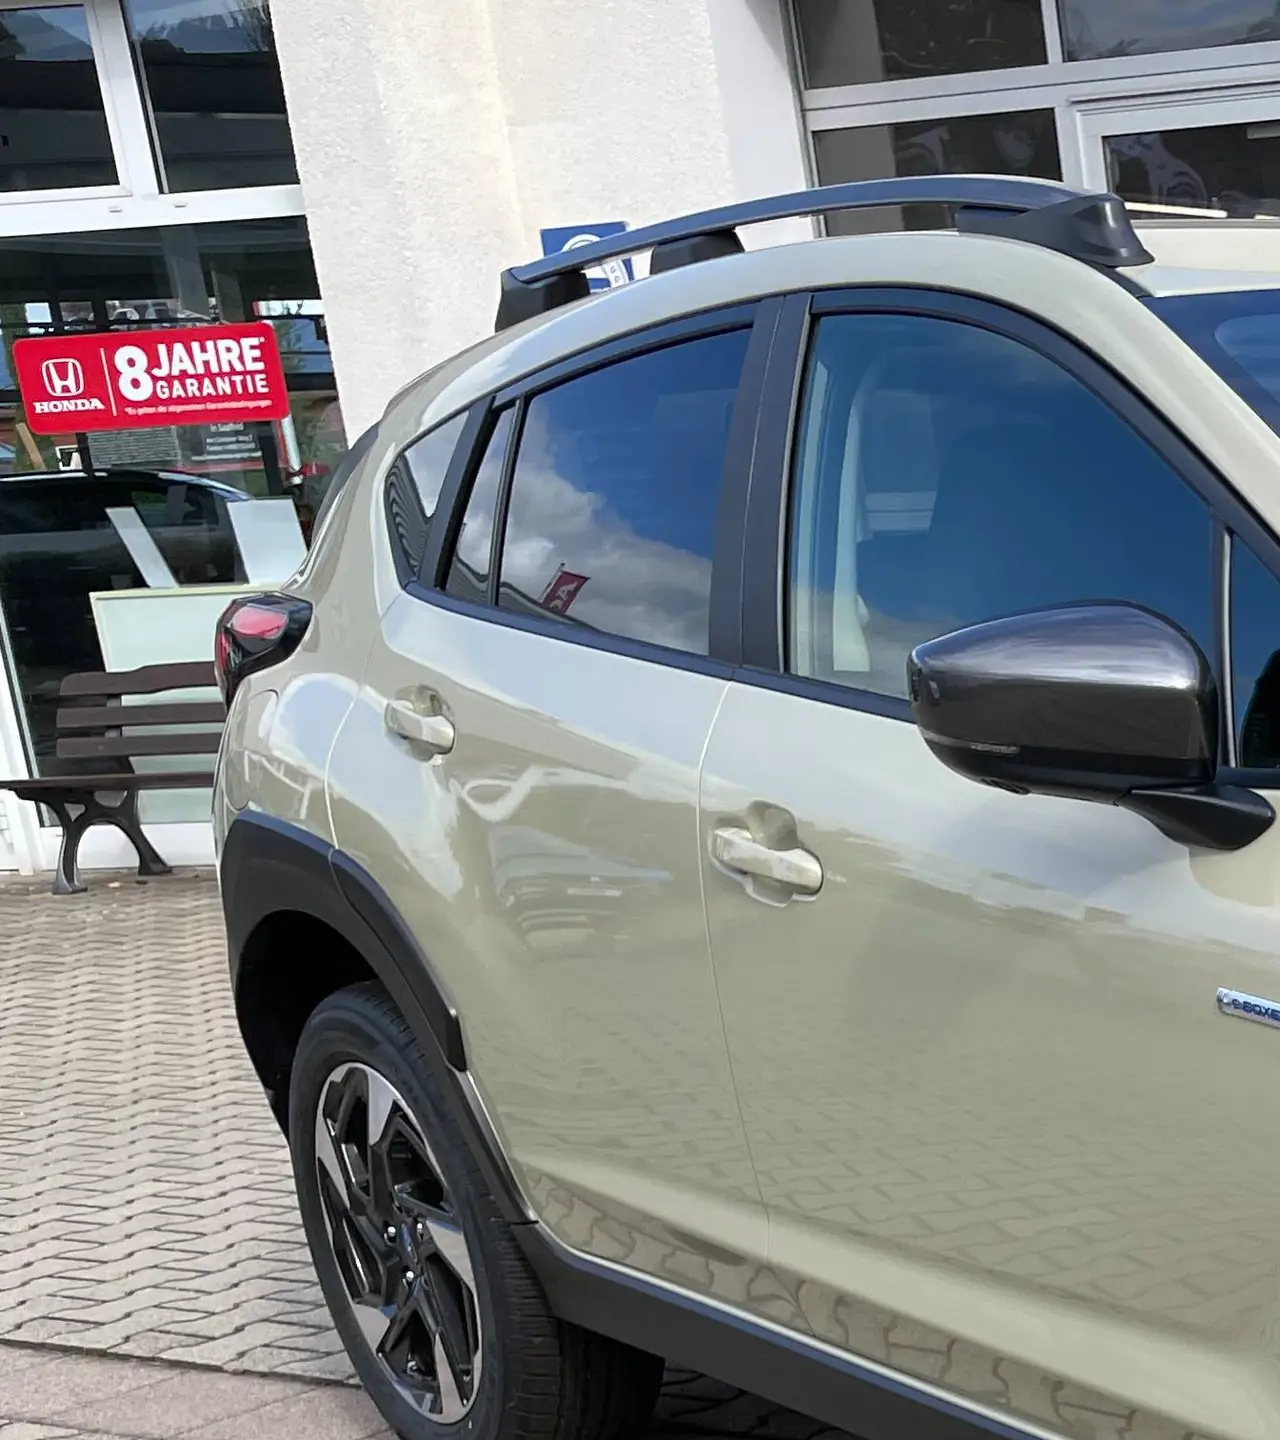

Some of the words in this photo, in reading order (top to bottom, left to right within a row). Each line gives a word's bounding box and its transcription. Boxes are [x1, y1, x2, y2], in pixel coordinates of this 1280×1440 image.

[114, 344, 153, 401] 8
[155, 373, 270, 400] GARANTIE
[32, 398, 105, 414] HONDA
